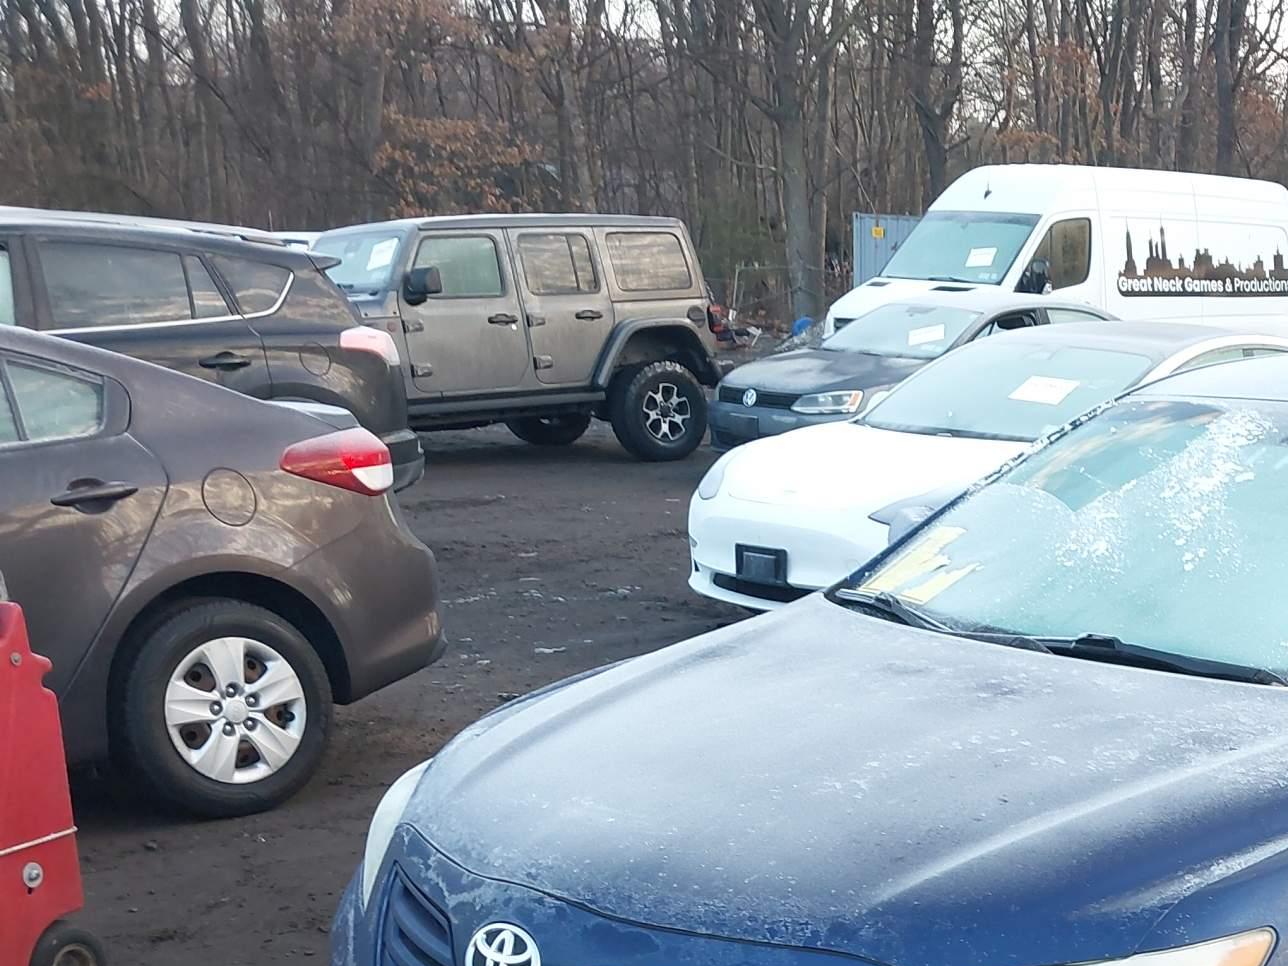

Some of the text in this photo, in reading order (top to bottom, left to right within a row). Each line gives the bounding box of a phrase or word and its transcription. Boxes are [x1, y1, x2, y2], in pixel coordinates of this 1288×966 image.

[1118, 276, 1151, 291] Great
[1153, 276, 1183, 292] Neck
[1184, 277, 1224, 292] Games
[1225, 278, 1233, 292] &
